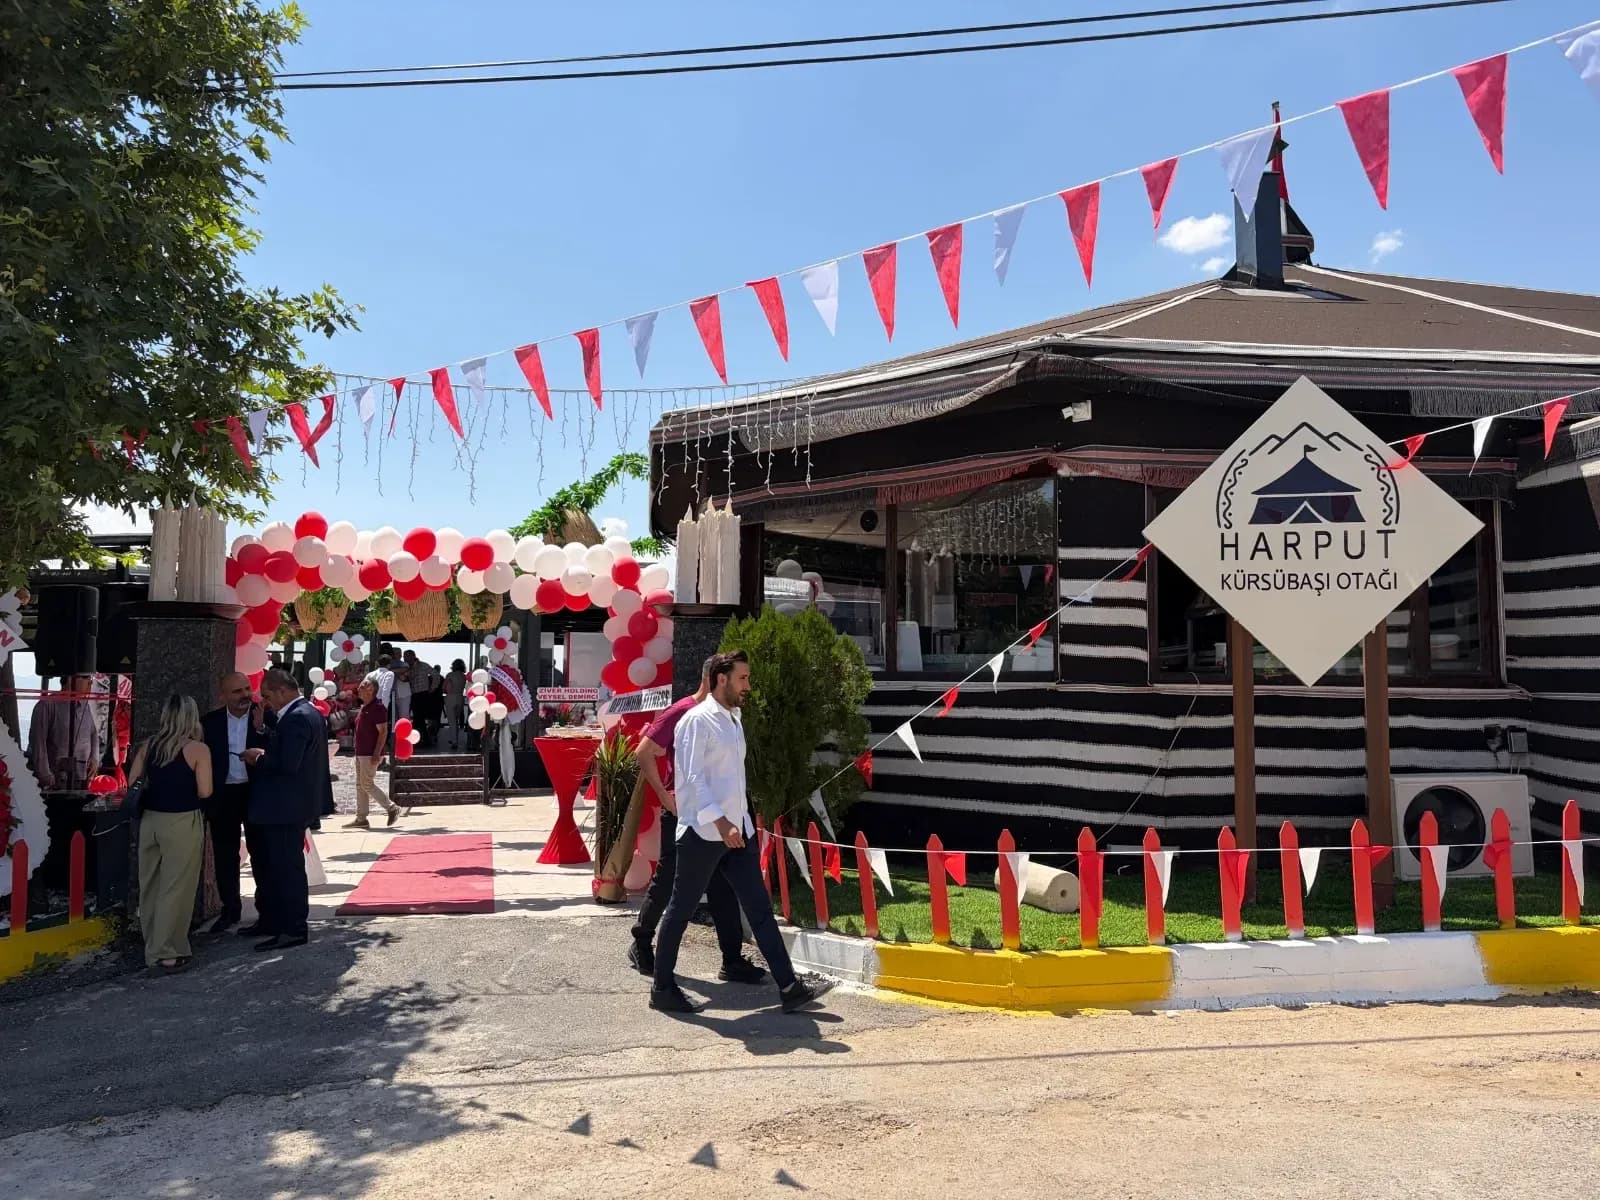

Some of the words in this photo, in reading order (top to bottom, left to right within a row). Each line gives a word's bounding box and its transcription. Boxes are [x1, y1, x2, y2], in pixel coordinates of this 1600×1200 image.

[1220, 529, 1397, 561] HARPUT
[1220, 569, 1330, 597] KÜRSÜBAŞI
[1336, 568, 1398, 590] OTAĞI
